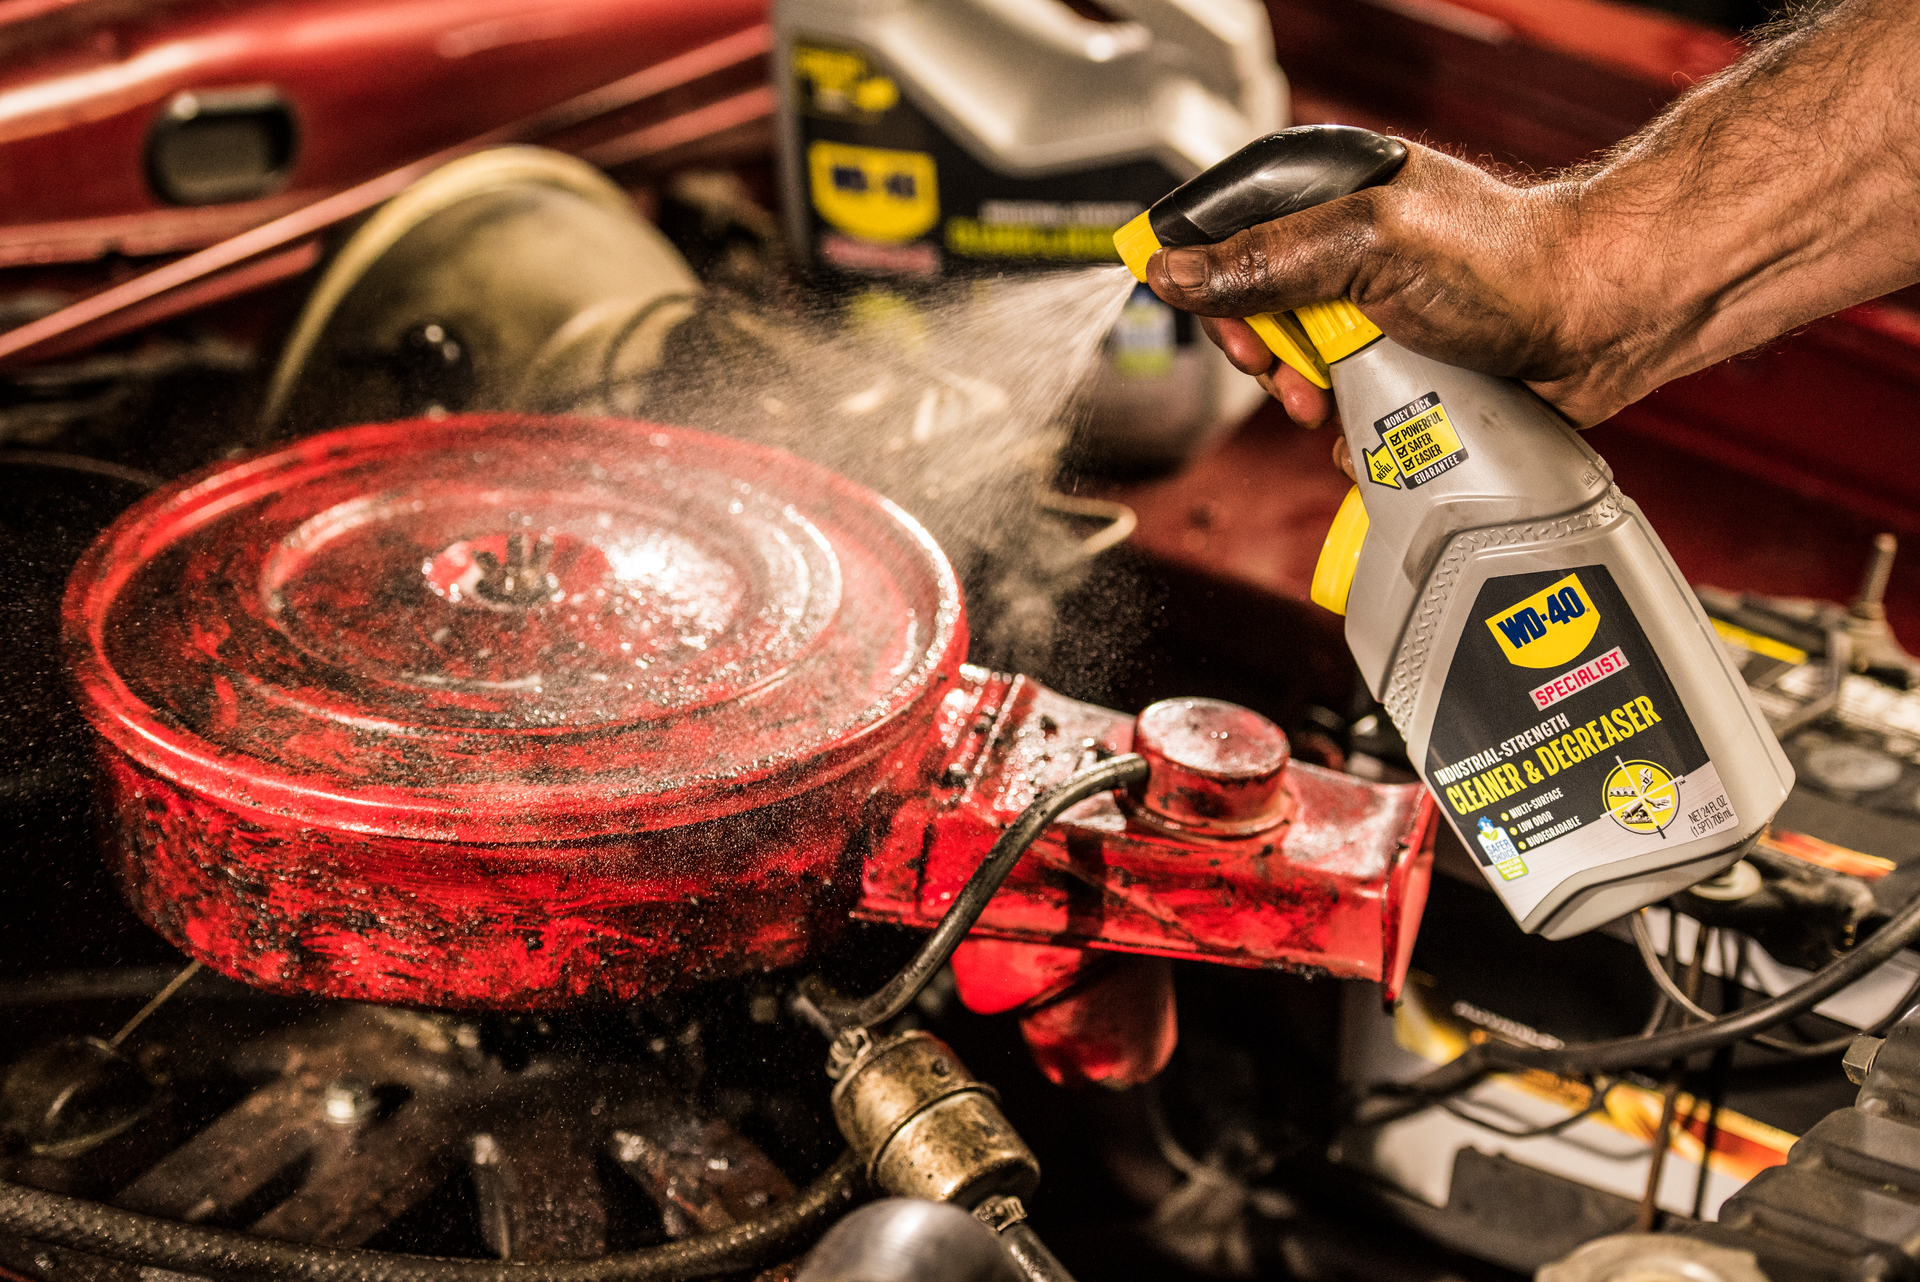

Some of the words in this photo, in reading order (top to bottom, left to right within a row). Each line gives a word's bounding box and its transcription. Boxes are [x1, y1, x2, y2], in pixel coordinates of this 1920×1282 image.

[1383, 408, 1410, 429] MONEY
[1410, 397, 1432, 415] BACK
[1401, 411, 1443, 440] POWERFUL
[1407, 432, 1433, 453] SAFER
[1414, 443, 1443, 466] EASIER
[1373, 460, 1384, 471] EZ
[1376, 462, 1394, 481] REFILL
[1414, 454, 1460, 485] GUARANTEE
[1496, 586, 1586, 649] WD-40
[1535, 651, 1621, 706] SPECIALIST
[1434, 712, 1571, 786] INDUSTRIAL-STRENGTH
[1446, 762, 1528, 816] CLEANER
[1522, 759, 1545, 785] &
[1535, 695, 1662, 777] DEGREASER
[1508, 787, 1564, 819] MULTI-SURFACE
[1688, 809, 1703, 824] NET
[1700, 805, 1711, 818] 24
[1708, 801, 1719, 813] FL
[1716, 794, 1728, 808] OZ
[1710, 812, 1725, 826] 709
[1722, 807, 1735, 820] mL
[1516, 818, 1535, 834] LOW
[1531, 810, 1554, 827] ODOR
[1525, 815, 1582, 848] BIODEGRADABLE
[1486, 838, 1512, 855] SAFER
[1491, 848, 1518, 863] CHOICE
